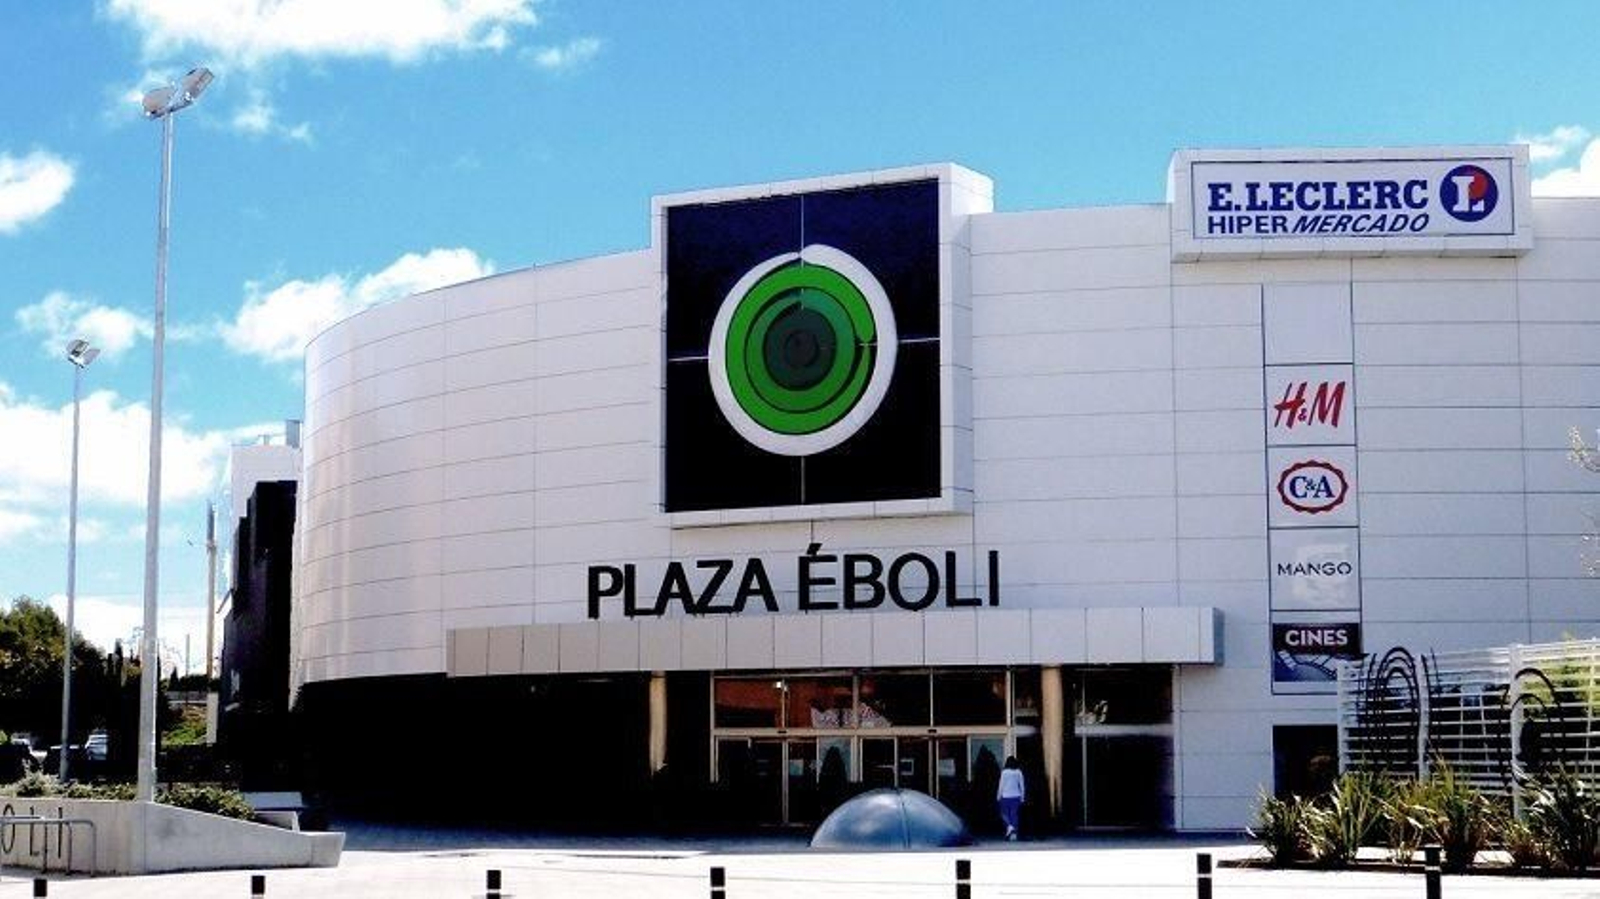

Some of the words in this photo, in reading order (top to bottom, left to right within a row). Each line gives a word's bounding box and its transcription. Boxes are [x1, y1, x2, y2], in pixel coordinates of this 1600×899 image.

[1207, 179, 1429, 211] E.LECLERC
[1209, 215, 1288, 234] HIPER
[1291, 213, 1429, 234] MERCADO
[1274, 381, 1346, 429] H&M
[1289, 475, 1335, 499] C&A
[1278, 561, 1352, 576] MANGO
[588, 558, 779, 619] PLAZA
[798, 543, 999, 611] ÉBOLI
[1285, 628, 1348, 647] CINES
